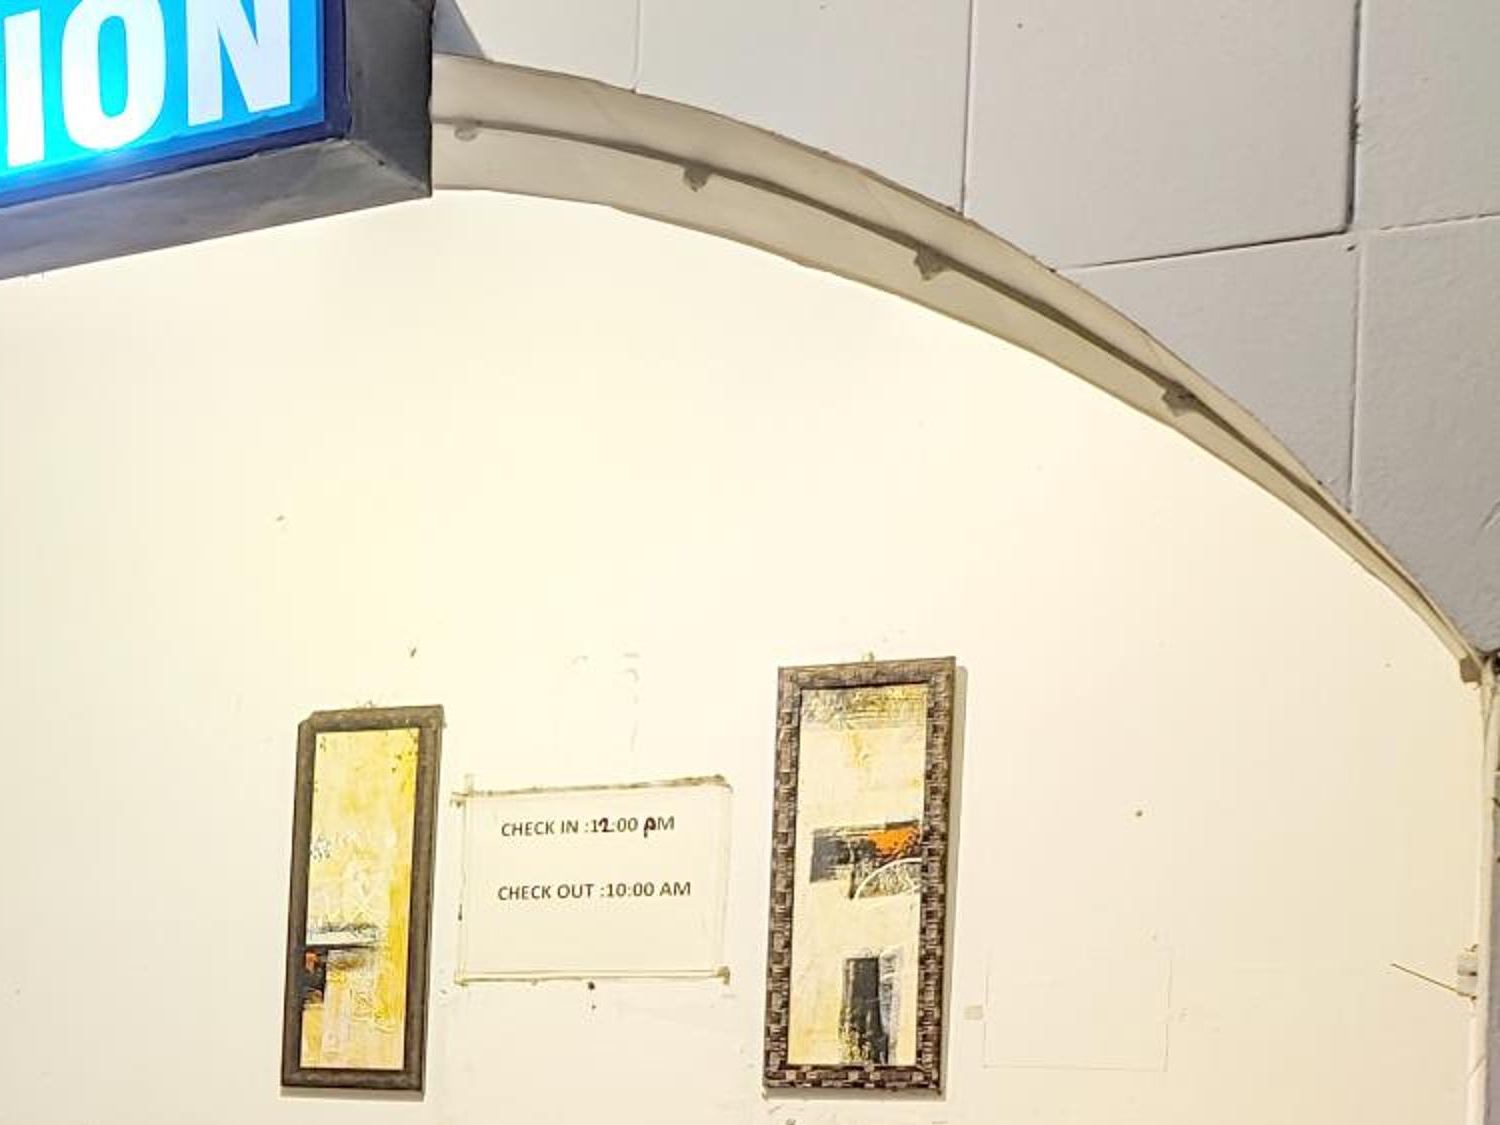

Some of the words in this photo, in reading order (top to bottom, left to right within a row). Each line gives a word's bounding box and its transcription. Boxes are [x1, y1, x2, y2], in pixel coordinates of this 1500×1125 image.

[501, 820, 554, 837] CHECK
[561, 819, 579, 834] IN
[498, 884, 551, 901] CHECK
[557, 883, 594, 898] OUT
[659, 882, 691, 897] AM
